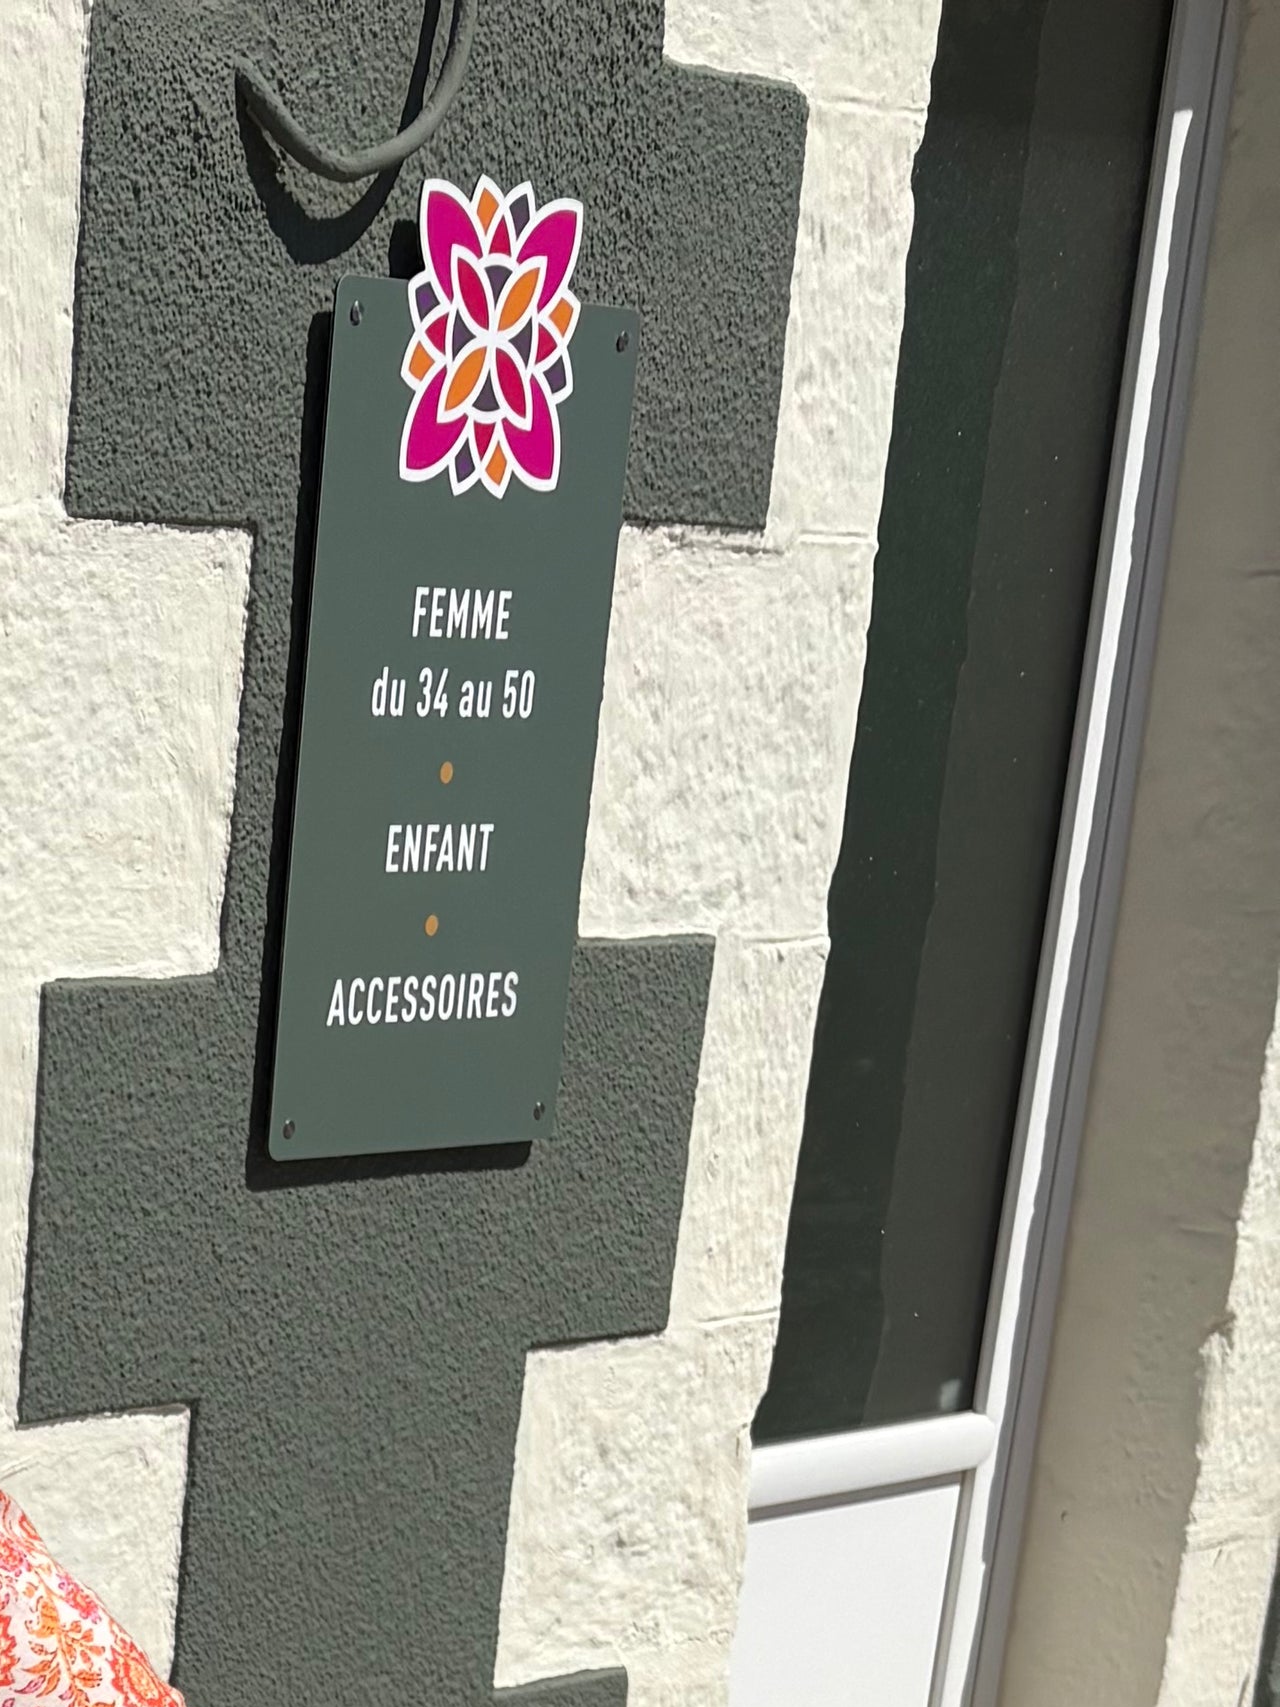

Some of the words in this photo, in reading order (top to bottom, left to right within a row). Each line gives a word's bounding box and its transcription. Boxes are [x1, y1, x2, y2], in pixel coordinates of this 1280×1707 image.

[412, 585, 512, 641] FEMME
[371, 667, 406, 718] du
[416, 667, 449, 718] 34
[458, 679, 493, 718] au
[502, 668, 536, 719] 50
[385, 822, 495, 873] ENFANT
[326, 970, 520, 1027] ACCESSOIRES
